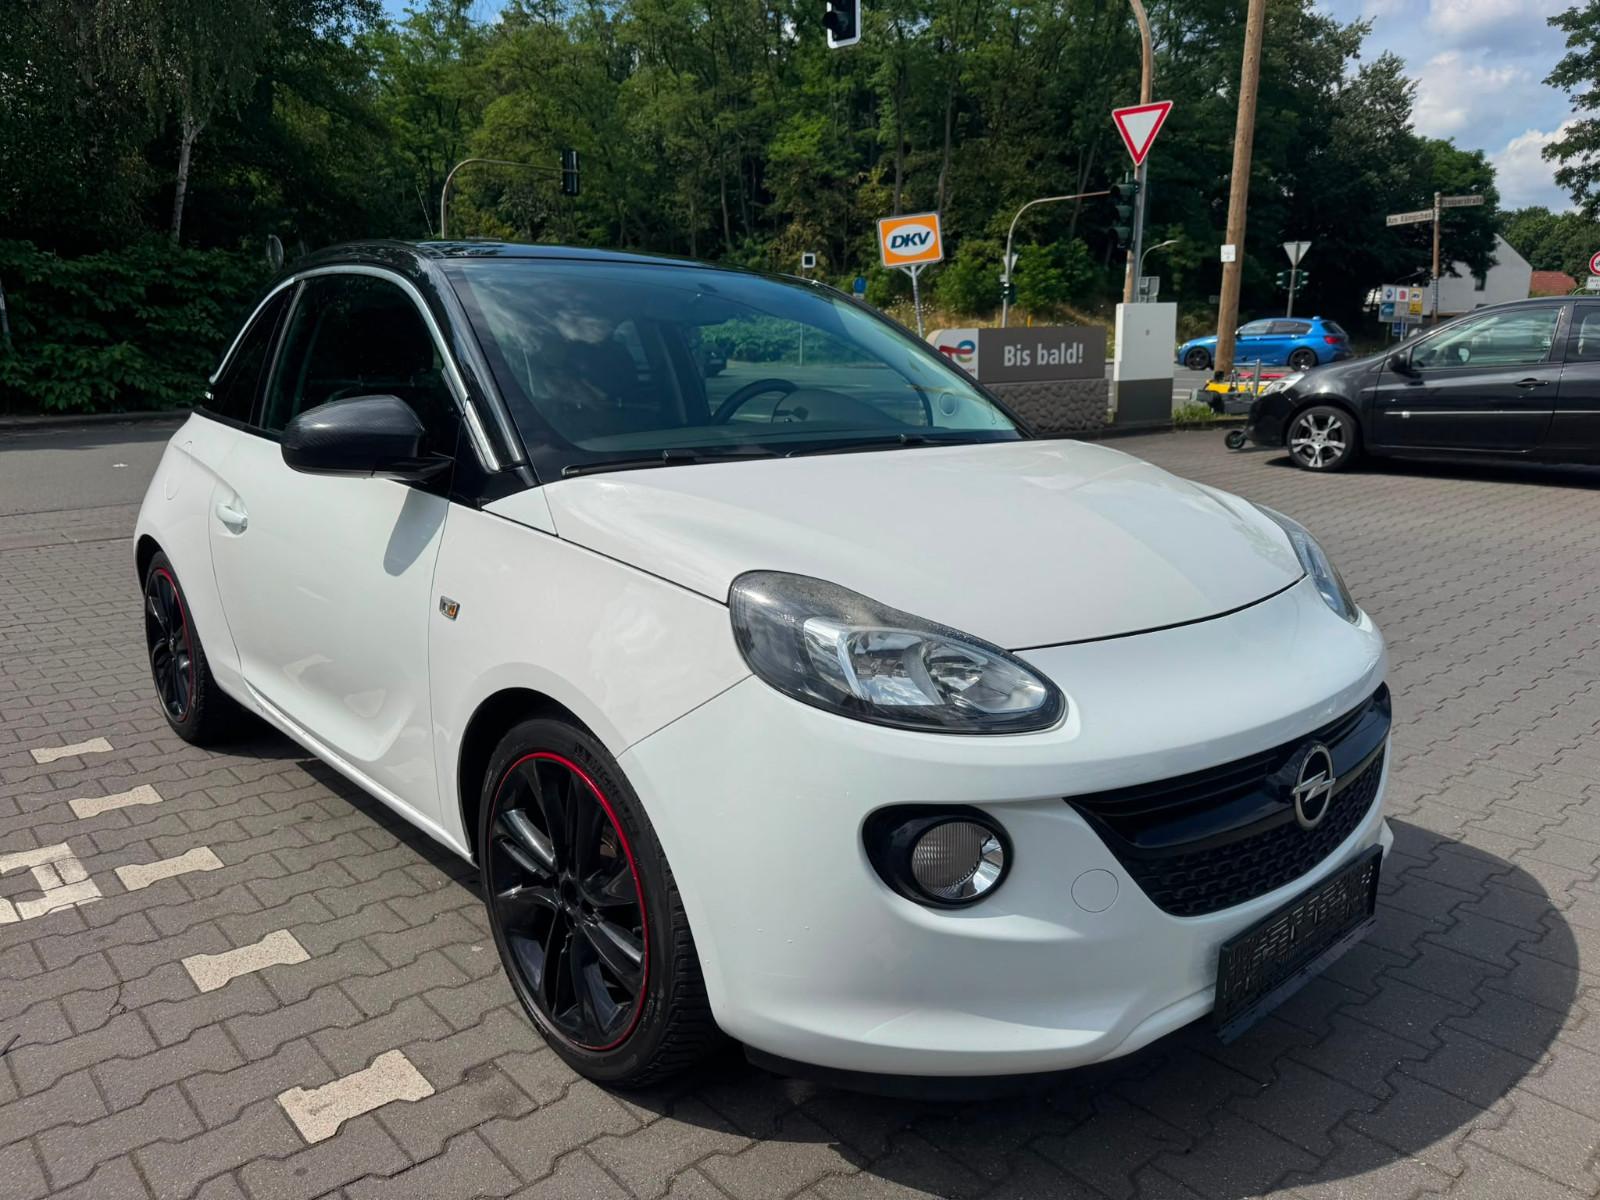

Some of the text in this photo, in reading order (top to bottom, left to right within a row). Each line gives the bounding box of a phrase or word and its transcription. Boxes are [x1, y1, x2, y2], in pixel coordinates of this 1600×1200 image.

[890, 230, 931, 250] DKV
[1003, 342, 1084, 367] Bis bald!
